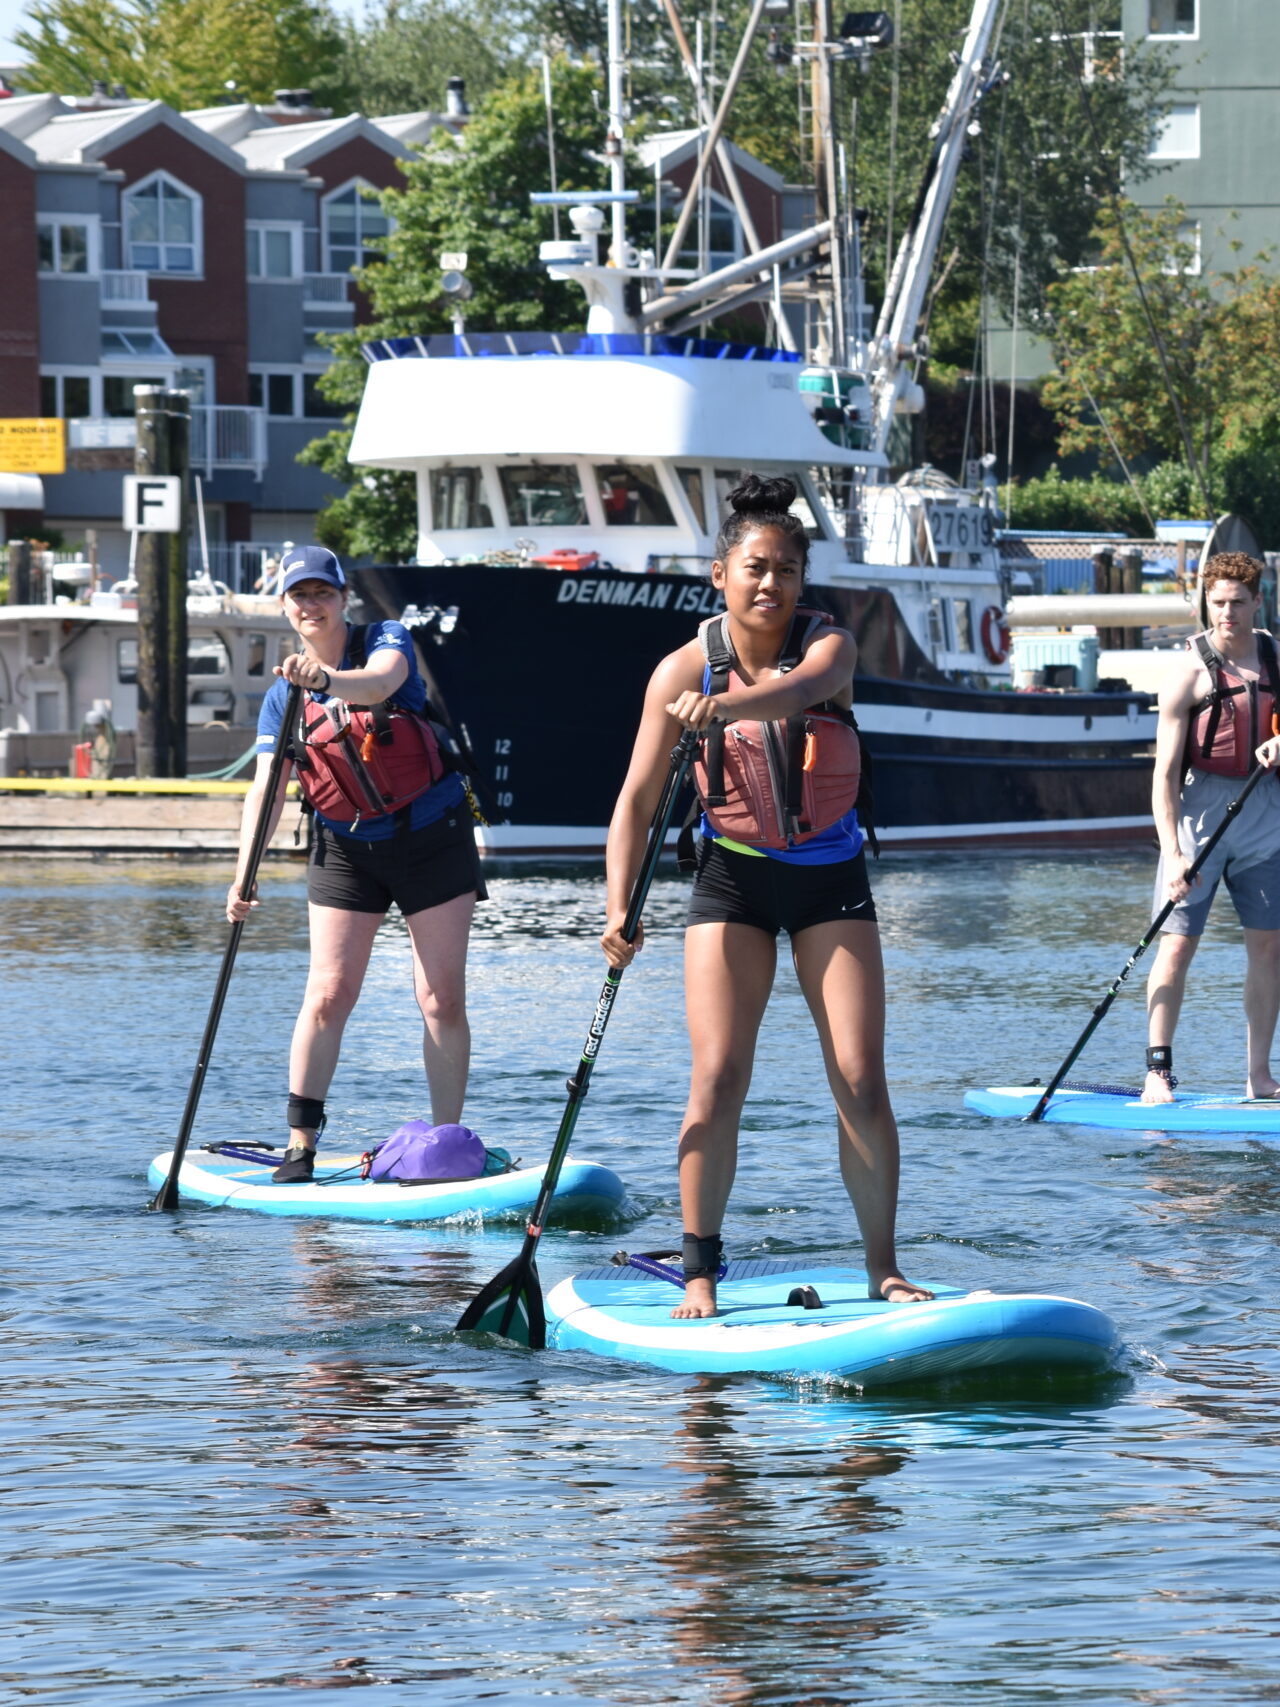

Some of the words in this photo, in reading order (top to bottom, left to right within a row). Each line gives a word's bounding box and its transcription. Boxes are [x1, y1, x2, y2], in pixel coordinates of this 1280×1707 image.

[137, 483, 167, 525] F
[557, 579, 671, 609] DENMAN
[495, 738, 511, 755] 12
[495, 764, 508, 781] 11
[497, 791, 513, 808] 10
[584, 1032, 600, 1057] red
